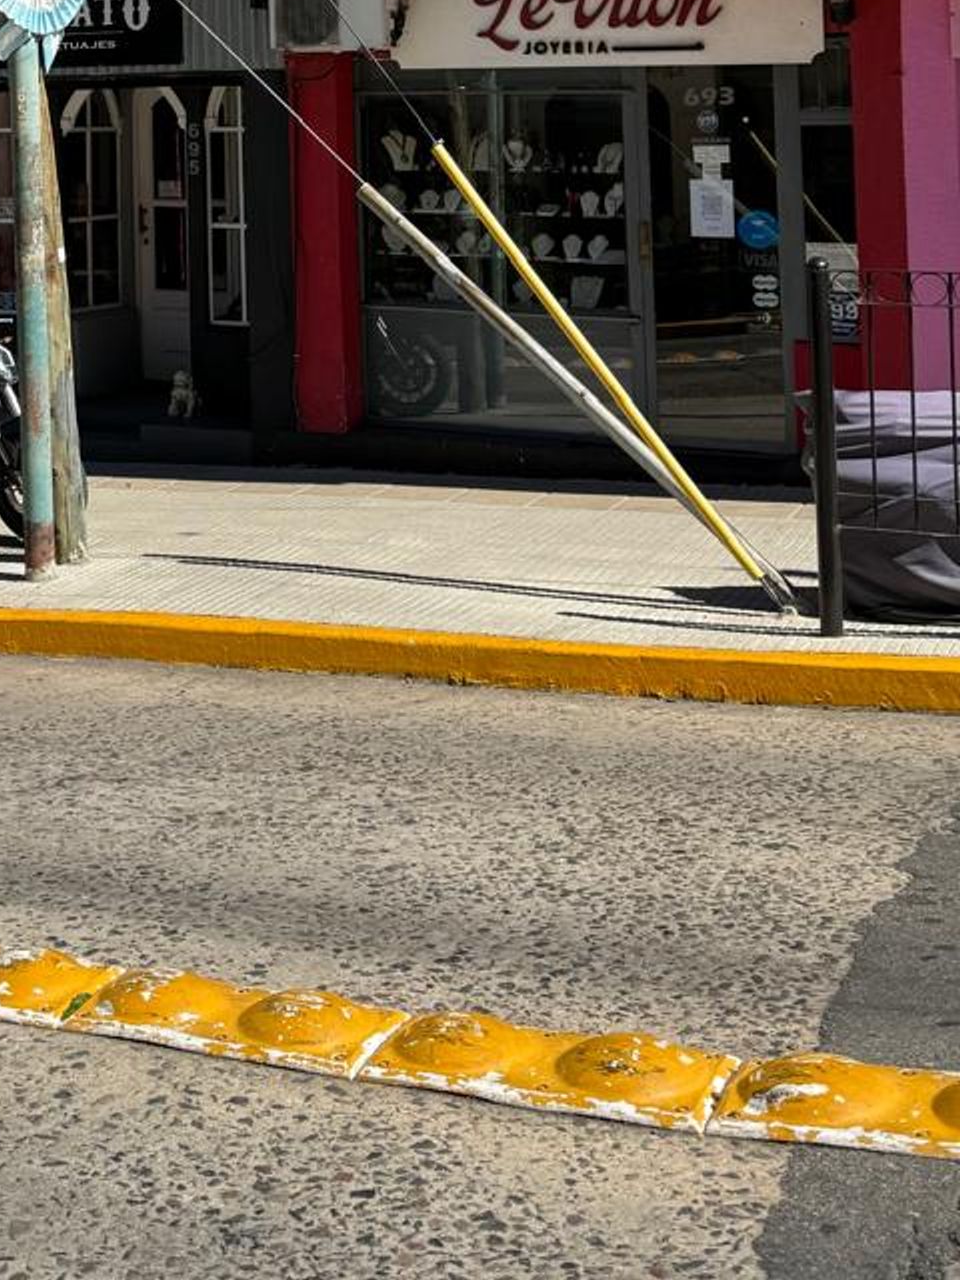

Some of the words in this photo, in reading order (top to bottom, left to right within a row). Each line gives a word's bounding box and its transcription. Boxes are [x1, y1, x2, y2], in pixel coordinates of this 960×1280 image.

[61, 39, 116, 51] TUAJES
[522, 40, 609, 55] JOYERIA
[683, 86, 735, 106] 693
[187, 123, 200, 176] 695
